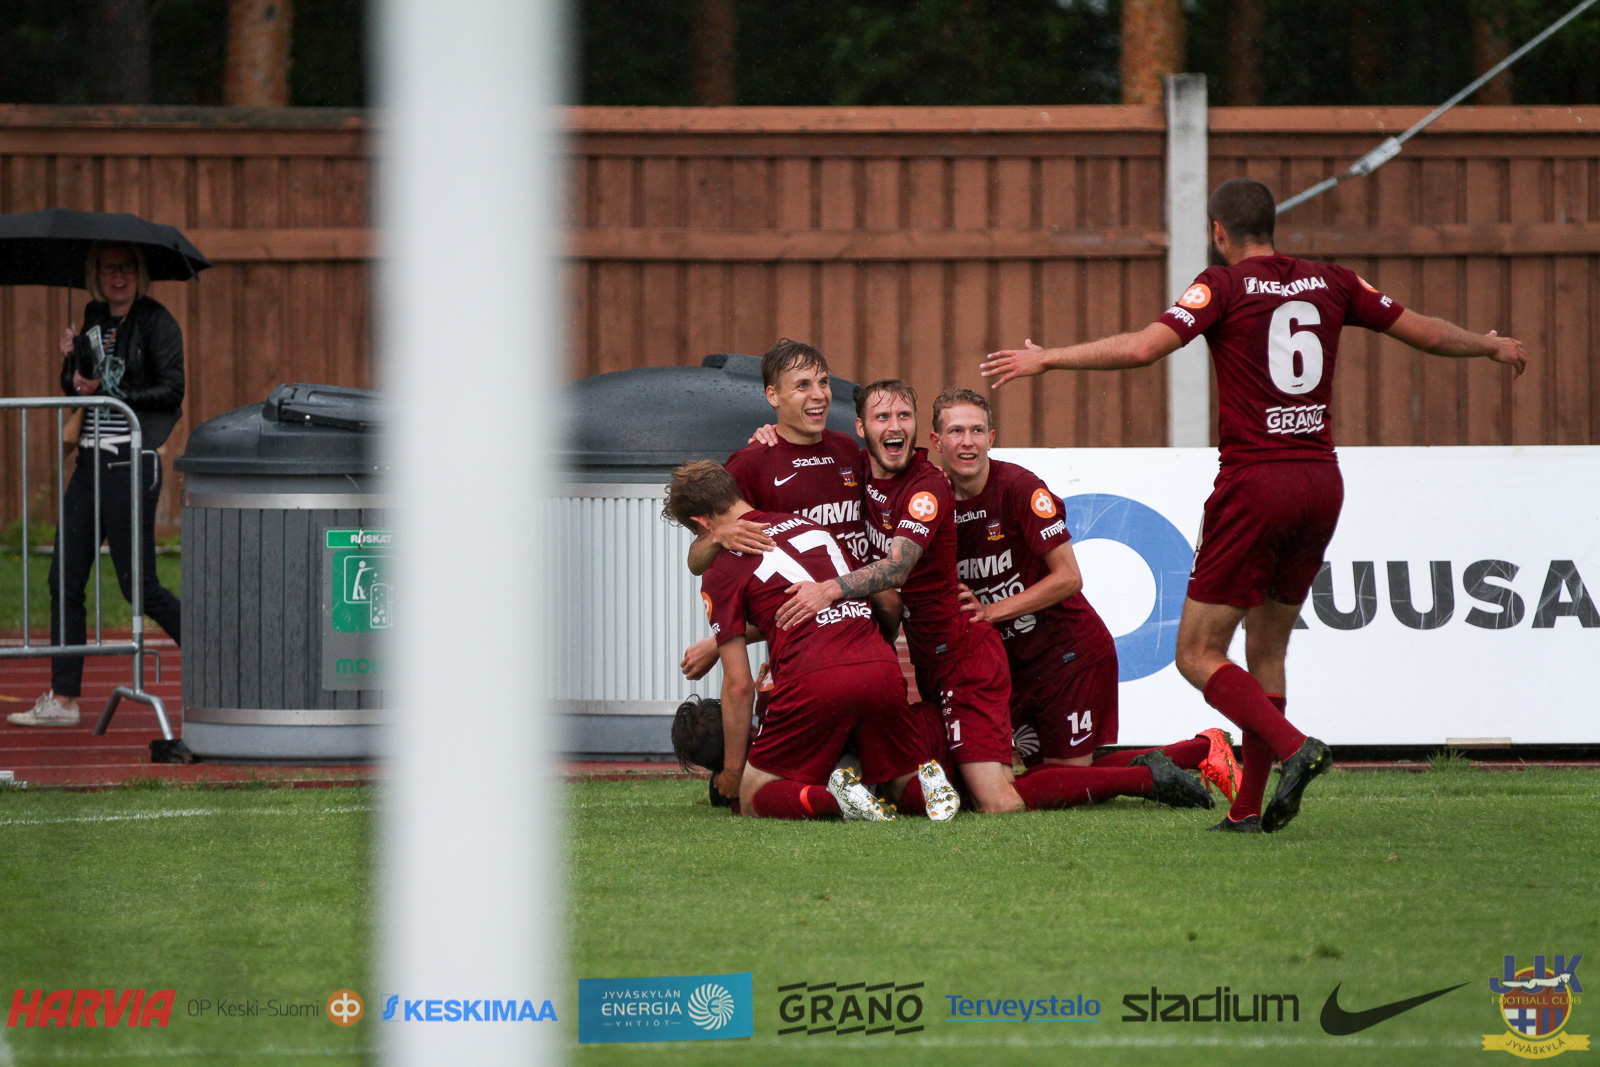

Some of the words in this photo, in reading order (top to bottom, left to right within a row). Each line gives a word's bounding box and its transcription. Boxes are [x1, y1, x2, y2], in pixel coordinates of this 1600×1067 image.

[1259, 276, 1328, 297] KEKIMAA
[1268, 300, 1323, 394] 6
[1266, 407, 1324, 431] GRANO
[954, 509, 987, 523] tadium
[753, 530, 850, 583] 17
[956, 549, 1012, 580] ARVIA
[1293, 559, 1600, 630] UUSA
[815, 604, 873, 627] GRANO
[1067, 710, 1093, 735] 14
